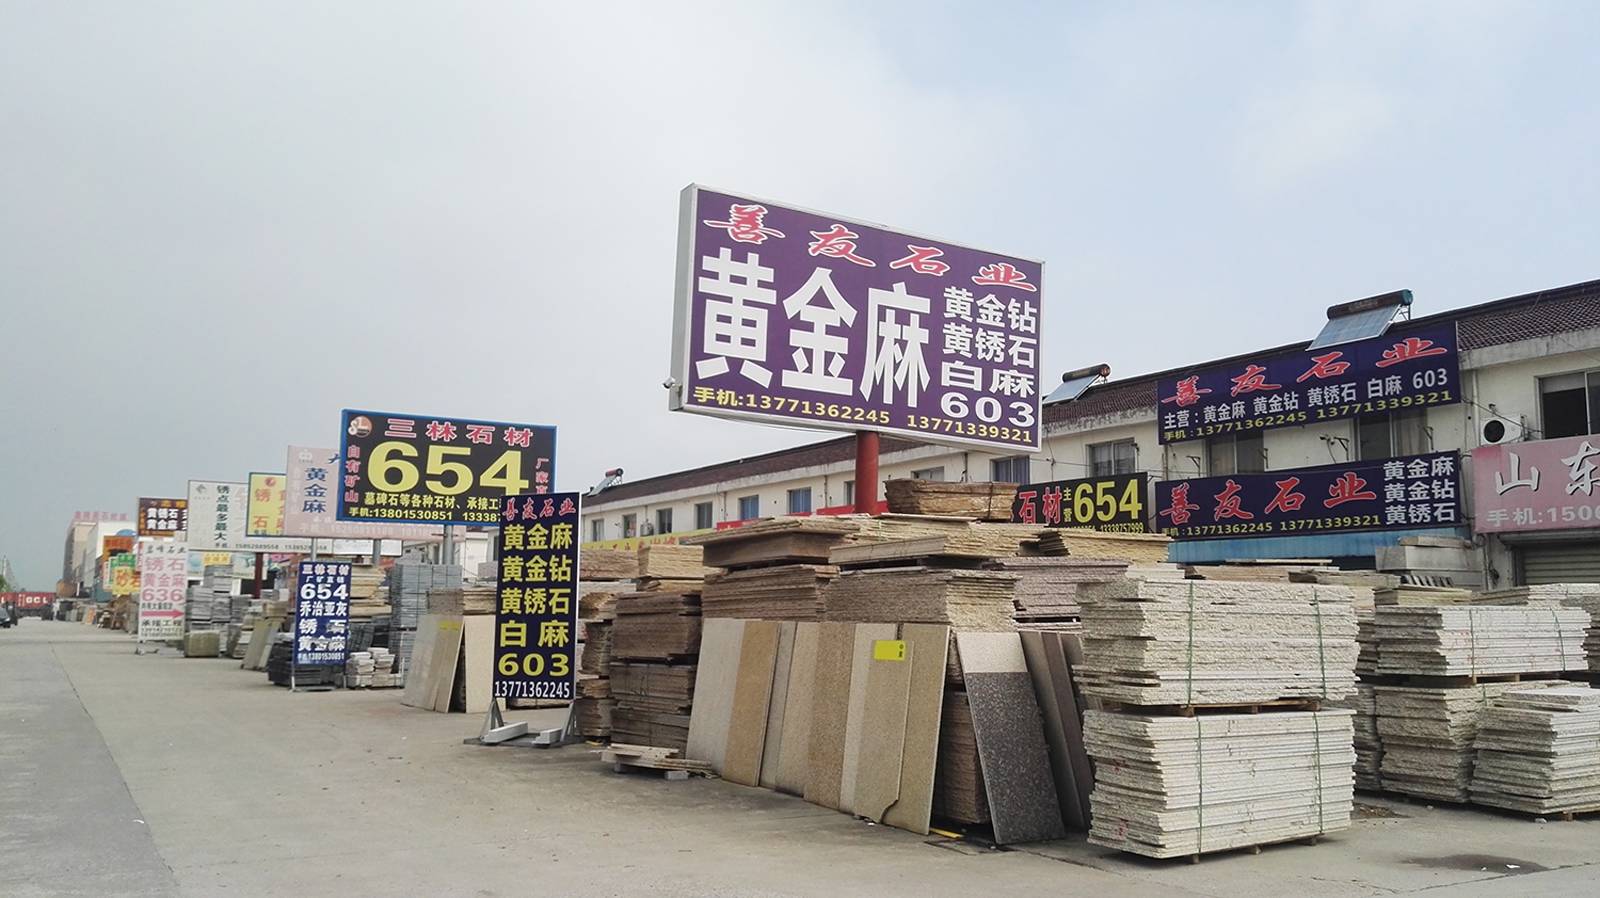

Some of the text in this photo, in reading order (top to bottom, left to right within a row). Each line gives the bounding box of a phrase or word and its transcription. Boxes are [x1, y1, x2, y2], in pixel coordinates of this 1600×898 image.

[703, 203, 1037, 292] 善友石业
[943, 286, 1037, 334] 黄金钻
[695, 247, 931, 408] 黄金麻
[942, 322, 1037, 368] 黄锈石
[940, 361, 1035, 398] 白麻
[1161, 337, 1448, 407] 善友石业
[1254, 391, 1299, 416] 黄金钻
[1308, 382, 1357, 407] 黄锈石
[1368, 375, 1402, 399] 白麻
[1413, 369, 1447, 389] 603
[1317, 391, 1452, 419] 13771339321
[940, 392, 1035, 427] 603
[385, 418, 533, 447] 三林石材
[907, 415, 1032, 442] 13771339321
[344, 445, 361, 503] 自有矿山
[367, 441, 529, 496] 654
[1384, 457, 1454, 481] 黄金麻
[1495, 441, 1600, 496] 山东
[302, 467, 328, 514] 黄金麻
[364, 491, 501, 511] 墓碑石等各种石材、承接工
[1063, 487, 1072, 522] 主营
[1074, 479, 1142, 523] 654
[1160, 472, 1377, 526] 善友石业
[1384, 479, 1455, 503] 黄金钻
[502, 497, 577, 521] 善友石业
[1019, 486, 1062, 525] 石材
[1385, 502, 1455, 525] 黄锈石
[503, 522, 573, 551] 黄金麻
[1280, 514, 1380, 531] 13771339321
[502, 554, 573, 583] 黄金钻
[142, 588, 183, 602] 636
[300, 583, 348, 600] 654
[500, 587, 571, 615] 黄锈石
[300, 601, 347, 616] 乔治亚灰
[500, 620, 569, 648] 白麻
[498, 653, 569, 677] 603
[494, 681, 570, 698] 13771362245
